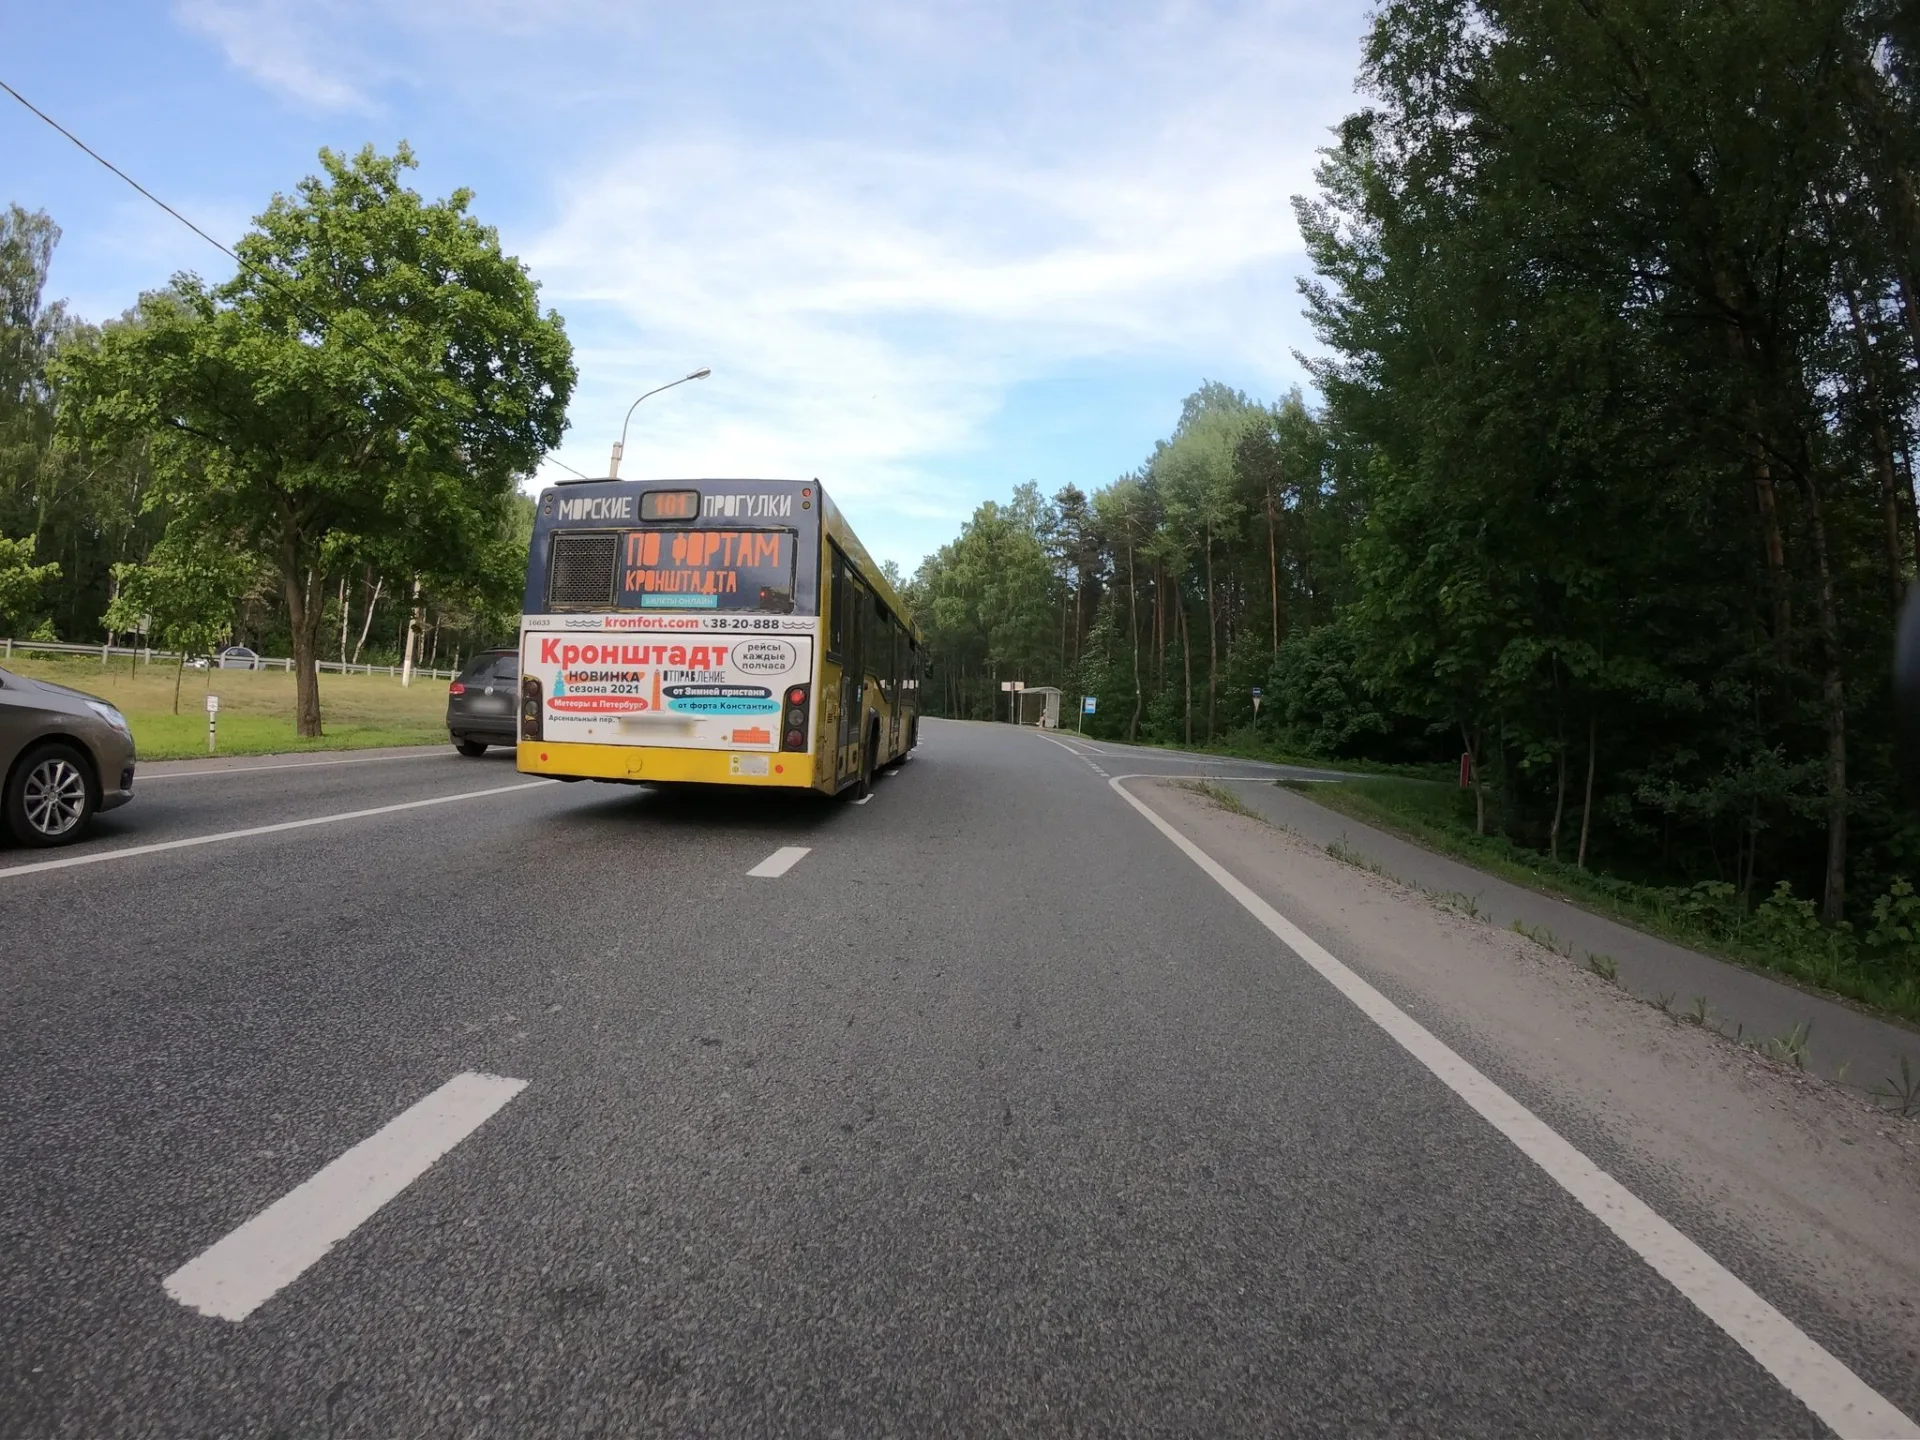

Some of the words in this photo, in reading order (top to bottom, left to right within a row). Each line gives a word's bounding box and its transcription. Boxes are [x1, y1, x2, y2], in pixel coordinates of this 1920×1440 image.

[557, 496, 632, 521] МОРСКИЕ
[703, 495, 792, 518] ПРОГУЛКИ
[626, 532, 661, 567] ПО
[672, 532, 781, 568] ФОРТАМ
[625, 570, 737, 595] КРОНШТАДТА
[645, 596, 677, 606] БИЛЕТЫ
[678, 596, 713, 606] ОНЛАЙН
[605, 616, 699, 630] kronfort.com
[710, 618, 780, 630] 38-20-888
[747, 642, 781, 653] рейсы
[541, 638, 729, 670] Кронштадт
[743, 653, 786, 661] каждые
[742, 662, 786, 670] полчаса
[569, 671, 640, 683] НОВИНКА
[663, 670, 726, 684] ОТПРАВЛЕНИЕ
[569, 685, 607, 694] сезона
[610, 684, 639, 694] 2021
[672, 687, 683, 695] от
[685, 687, 720, 697] Зимней
[721, 688, 765, 698] пристани
[554, 699, 590, 709] Метеоры
[599, 700, 643, 712] Петербург
[689, 702, 717, 711] форта
[720, 702, 774, 711] Константин
[548, 714, 598, 723] Арсенальный
[599, 716, 616, 724] пер.
